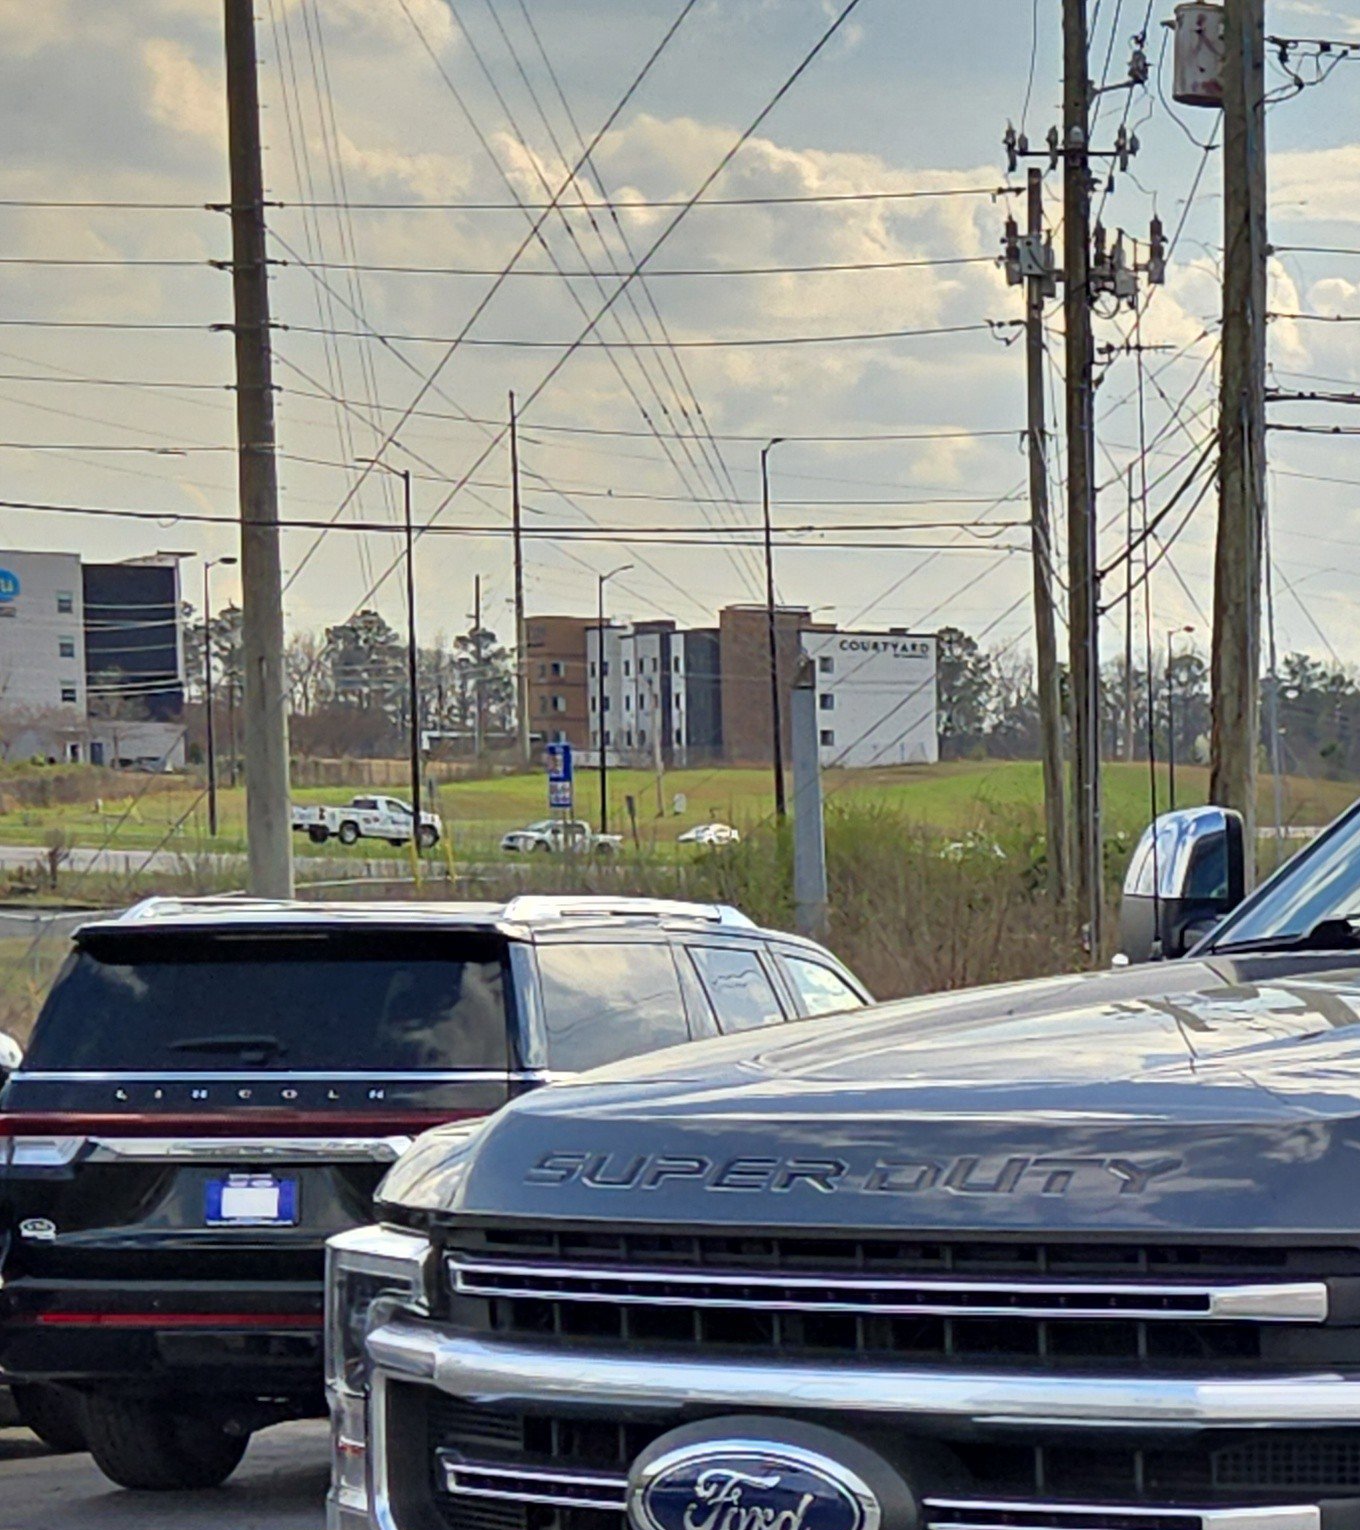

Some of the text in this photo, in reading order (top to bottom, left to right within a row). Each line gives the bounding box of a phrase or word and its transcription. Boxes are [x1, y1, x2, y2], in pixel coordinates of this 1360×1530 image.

[839, 639, 929, 653] COURTYARD
[115, 1087, 385, 1101] LINCOLN
[522, 1148, 1186, 1197] SUPER DUTY
